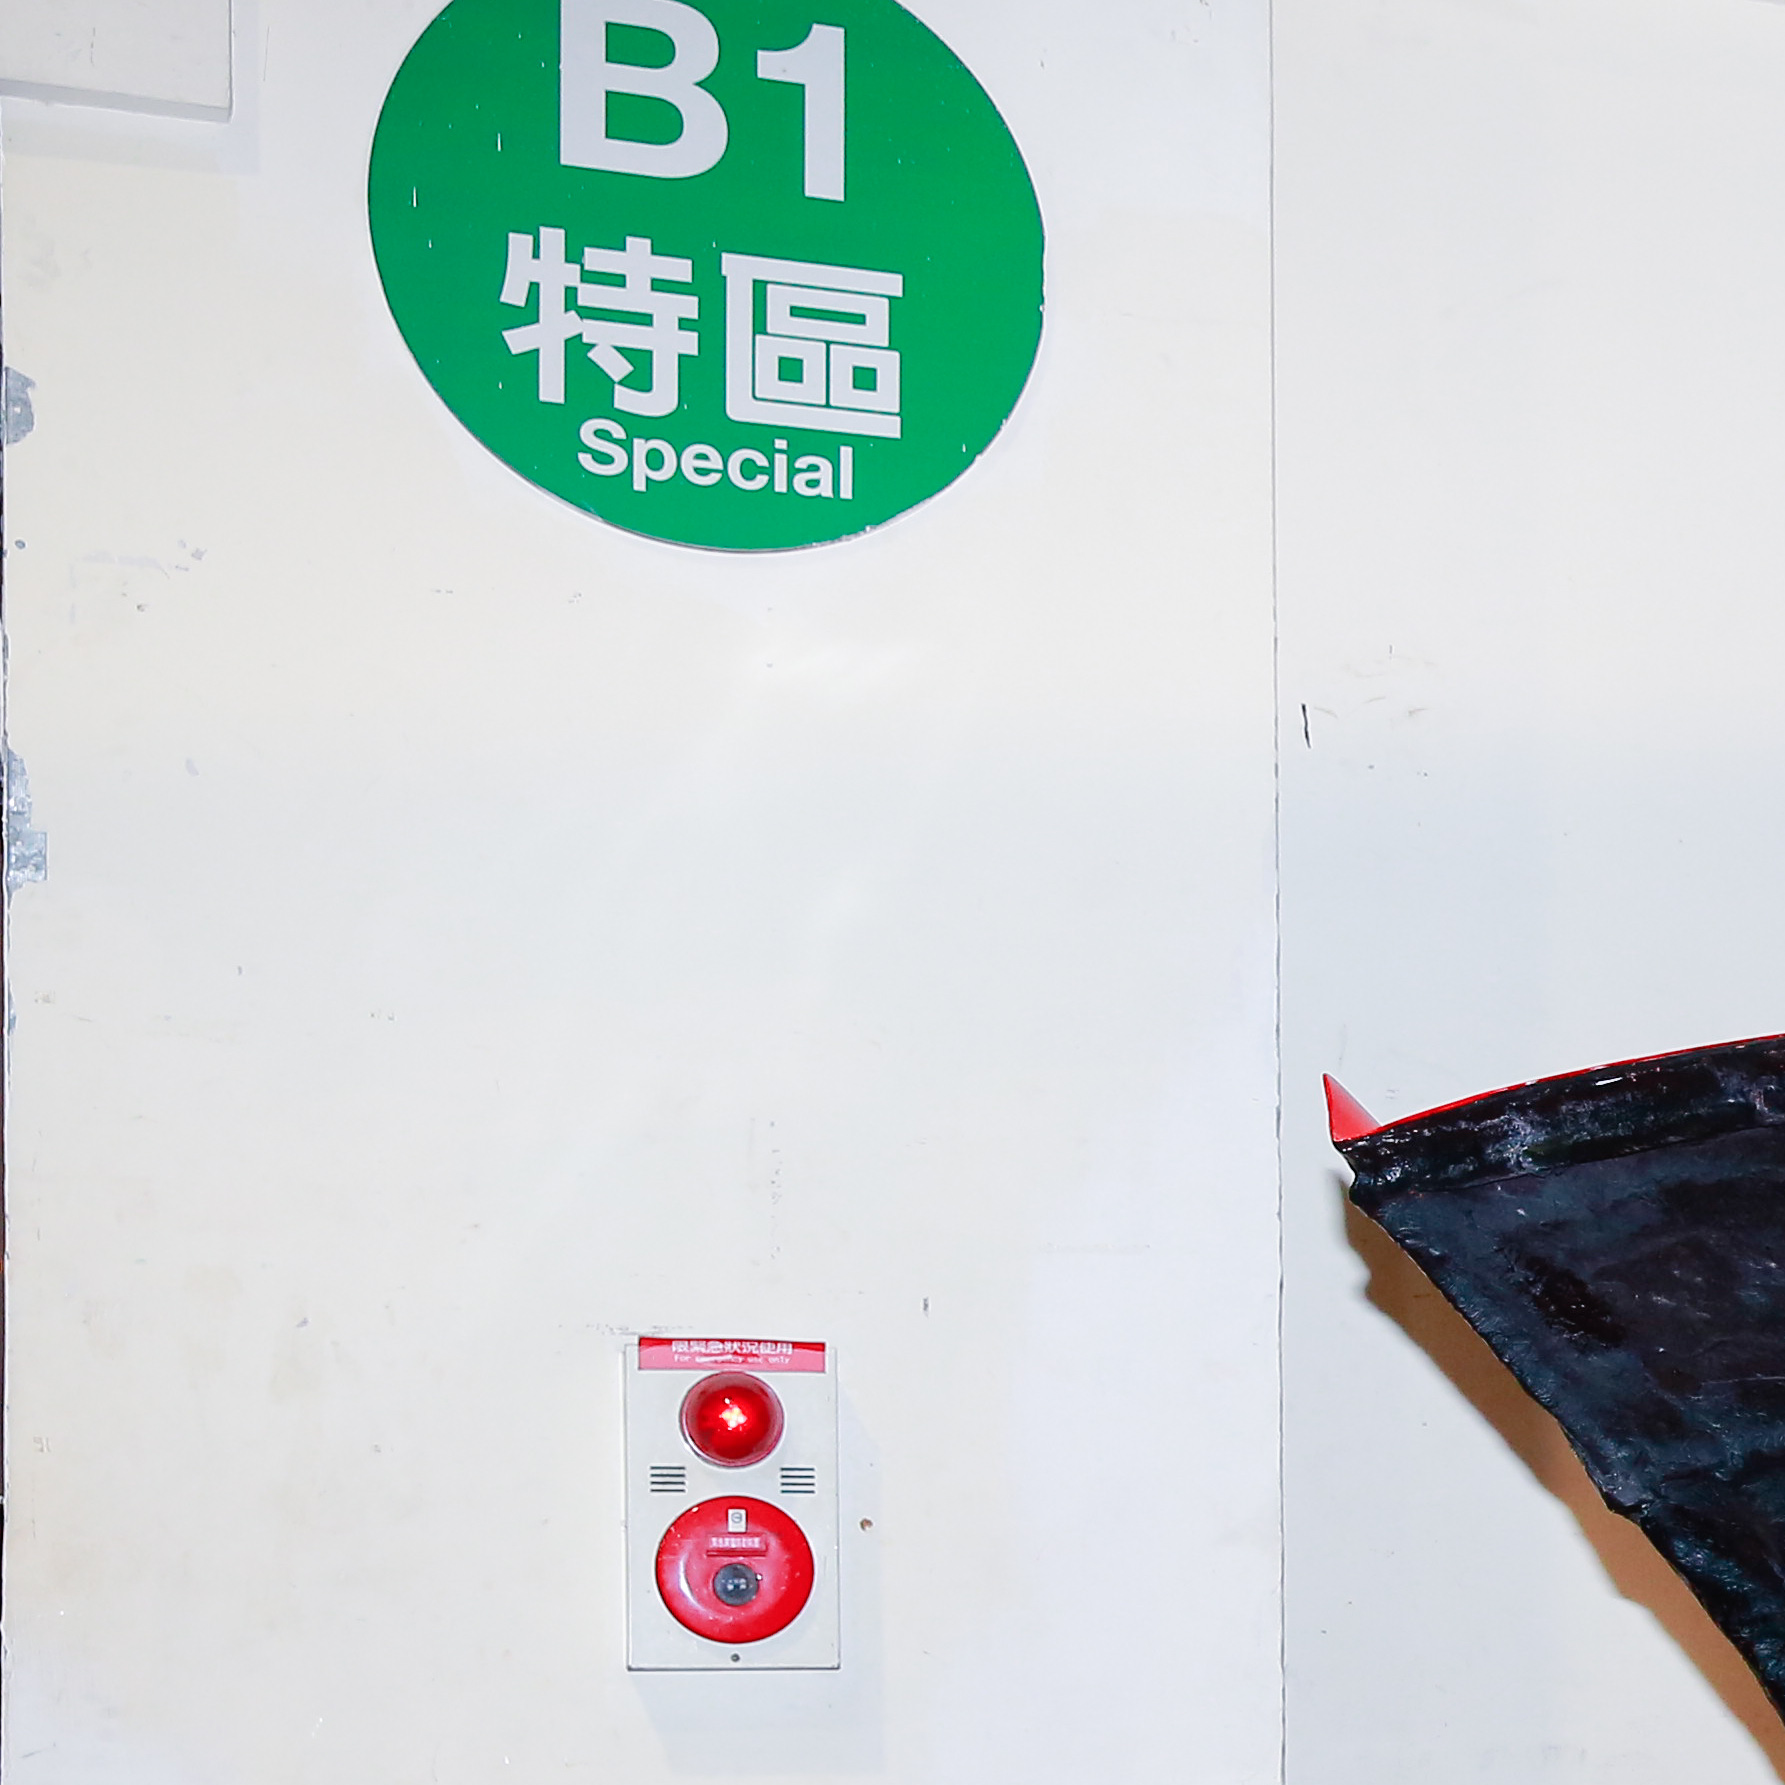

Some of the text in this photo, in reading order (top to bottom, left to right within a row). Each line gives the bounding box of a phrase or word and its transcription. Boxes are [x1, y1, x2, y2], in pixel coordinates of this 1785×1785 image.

[559, 0, 846, 202] B1
[500, 226, 904, 439] 特區
[577, 418, 855, 500] Special
